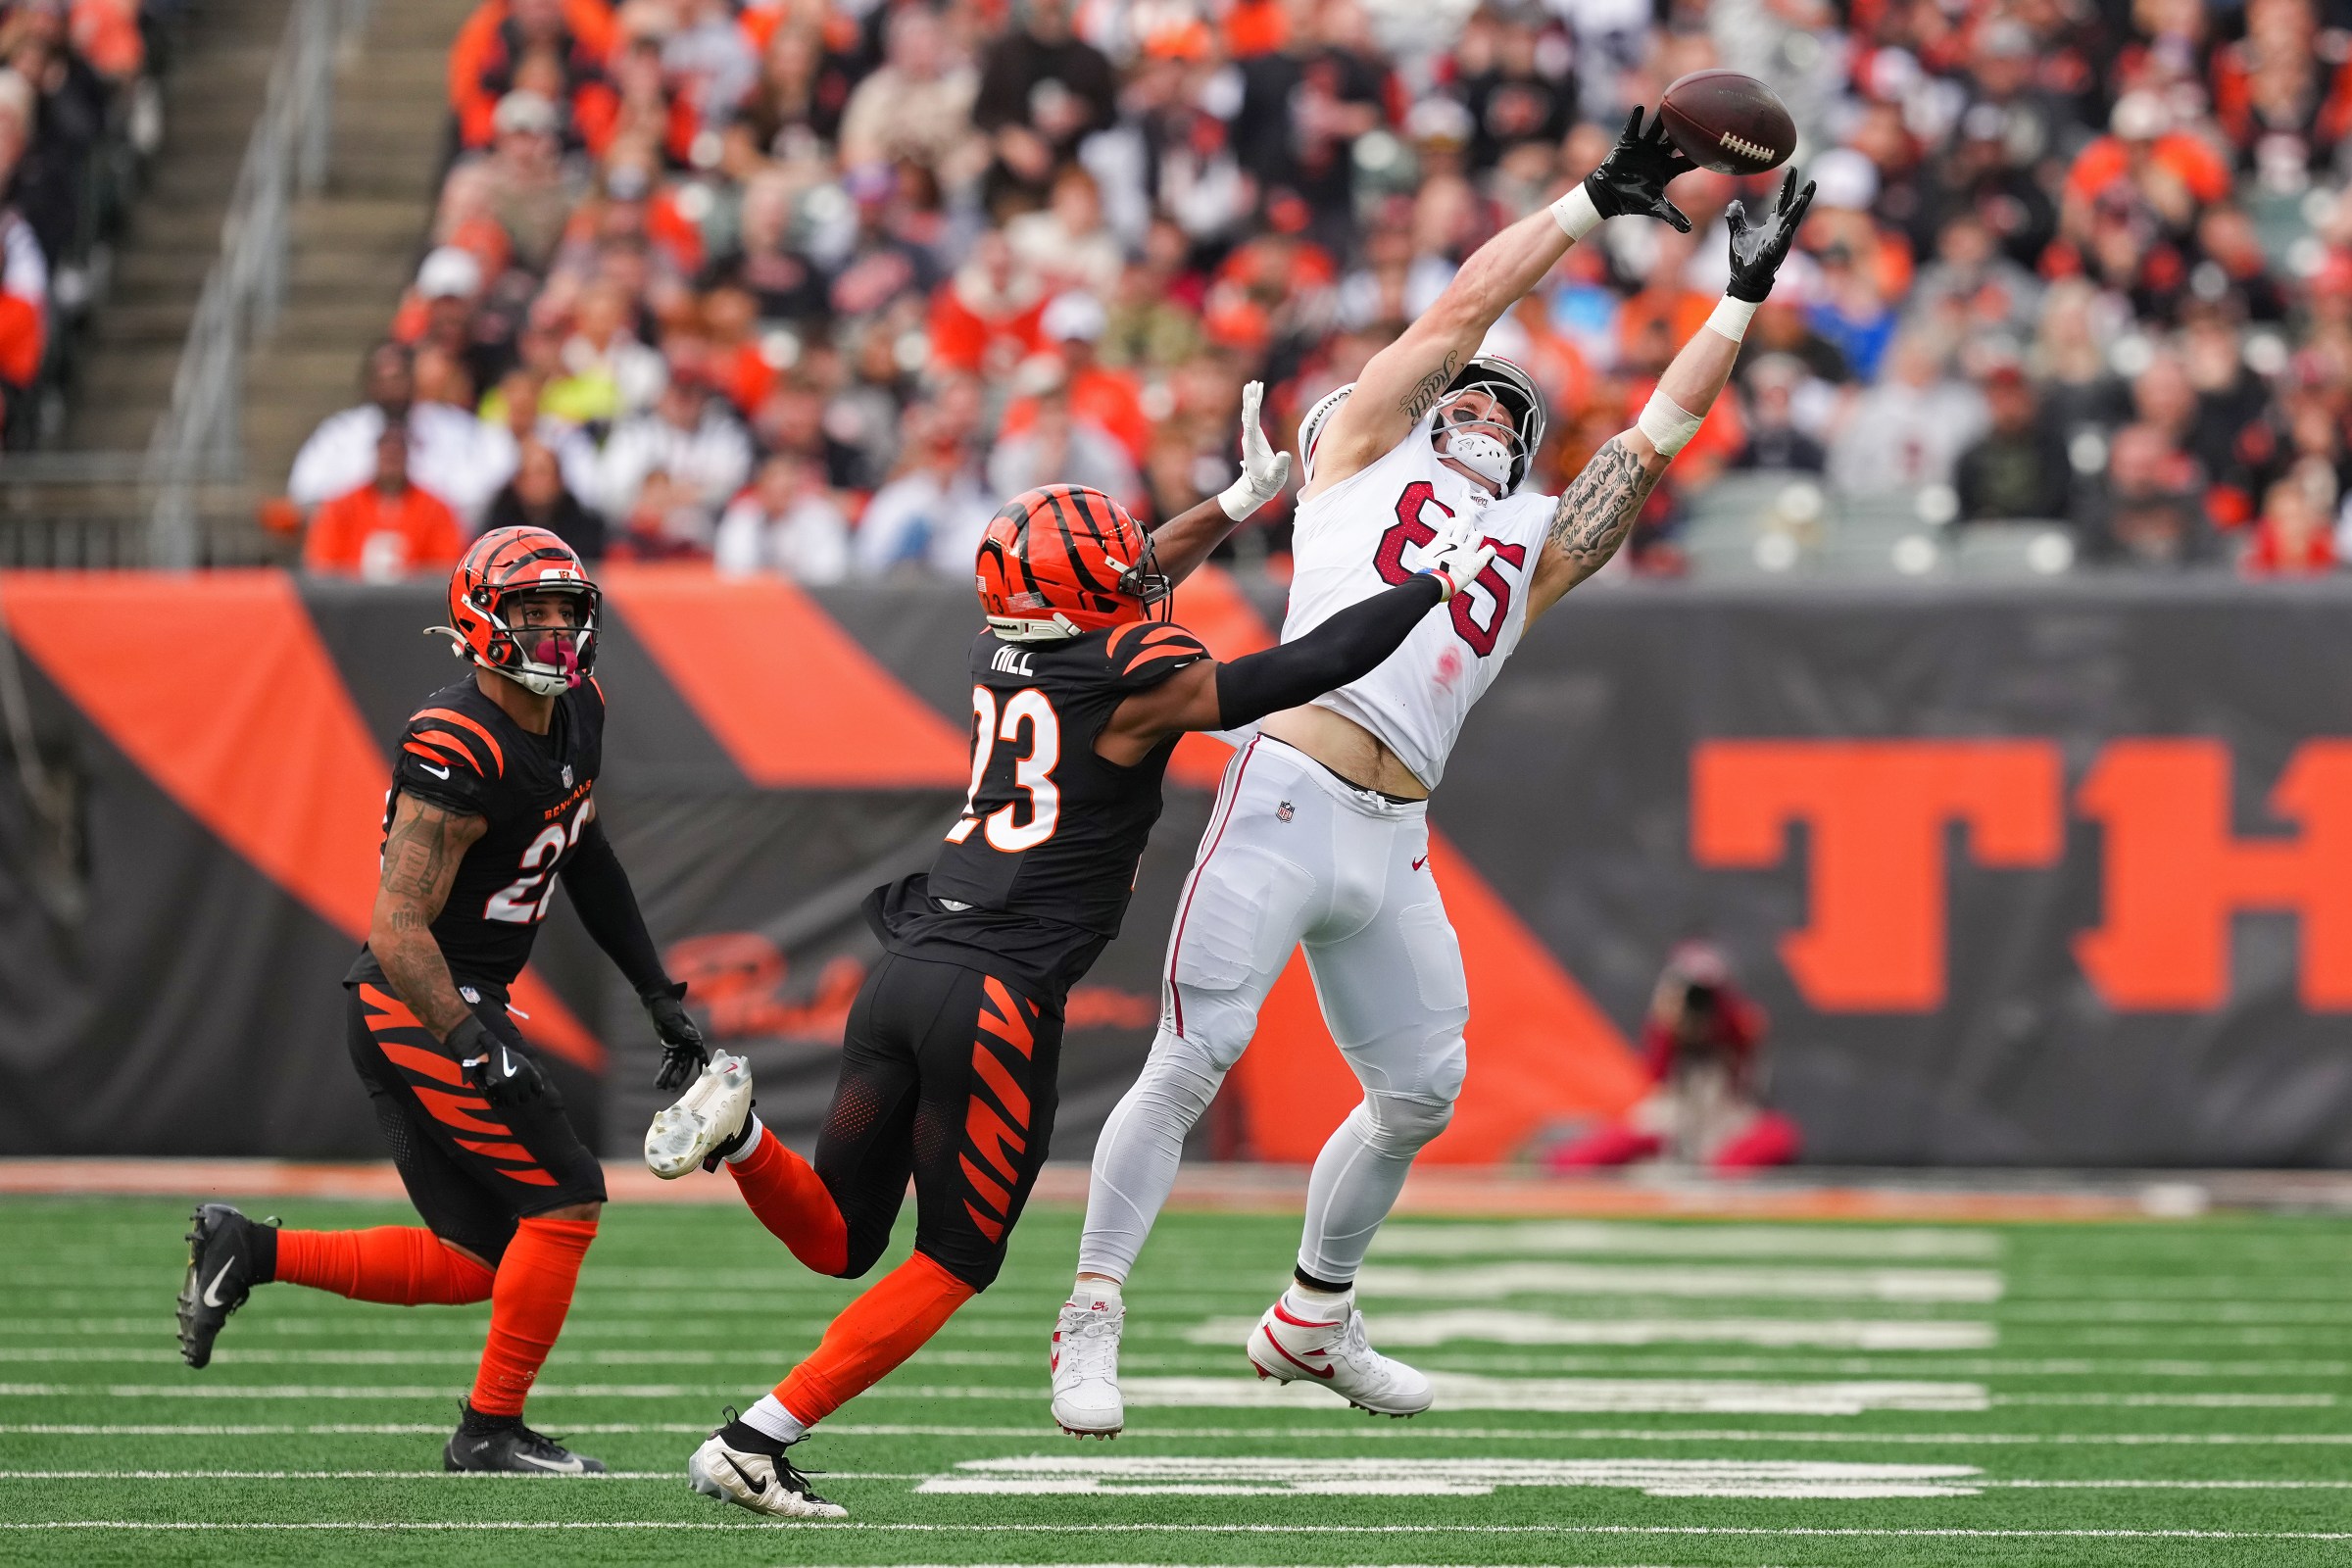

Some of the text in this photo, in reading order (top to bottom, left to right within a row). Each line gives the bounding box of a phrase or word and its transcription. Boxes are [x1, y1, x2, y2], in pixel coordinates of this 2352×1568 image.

[1573, 481, 1599, 514] Through
[1597, 456, 1617, 485] Christ
[982, 593, 1004, 615] 23
[544, 779, 592, 821] BENGALS
[1690, 737, 2352, 1013] TH
